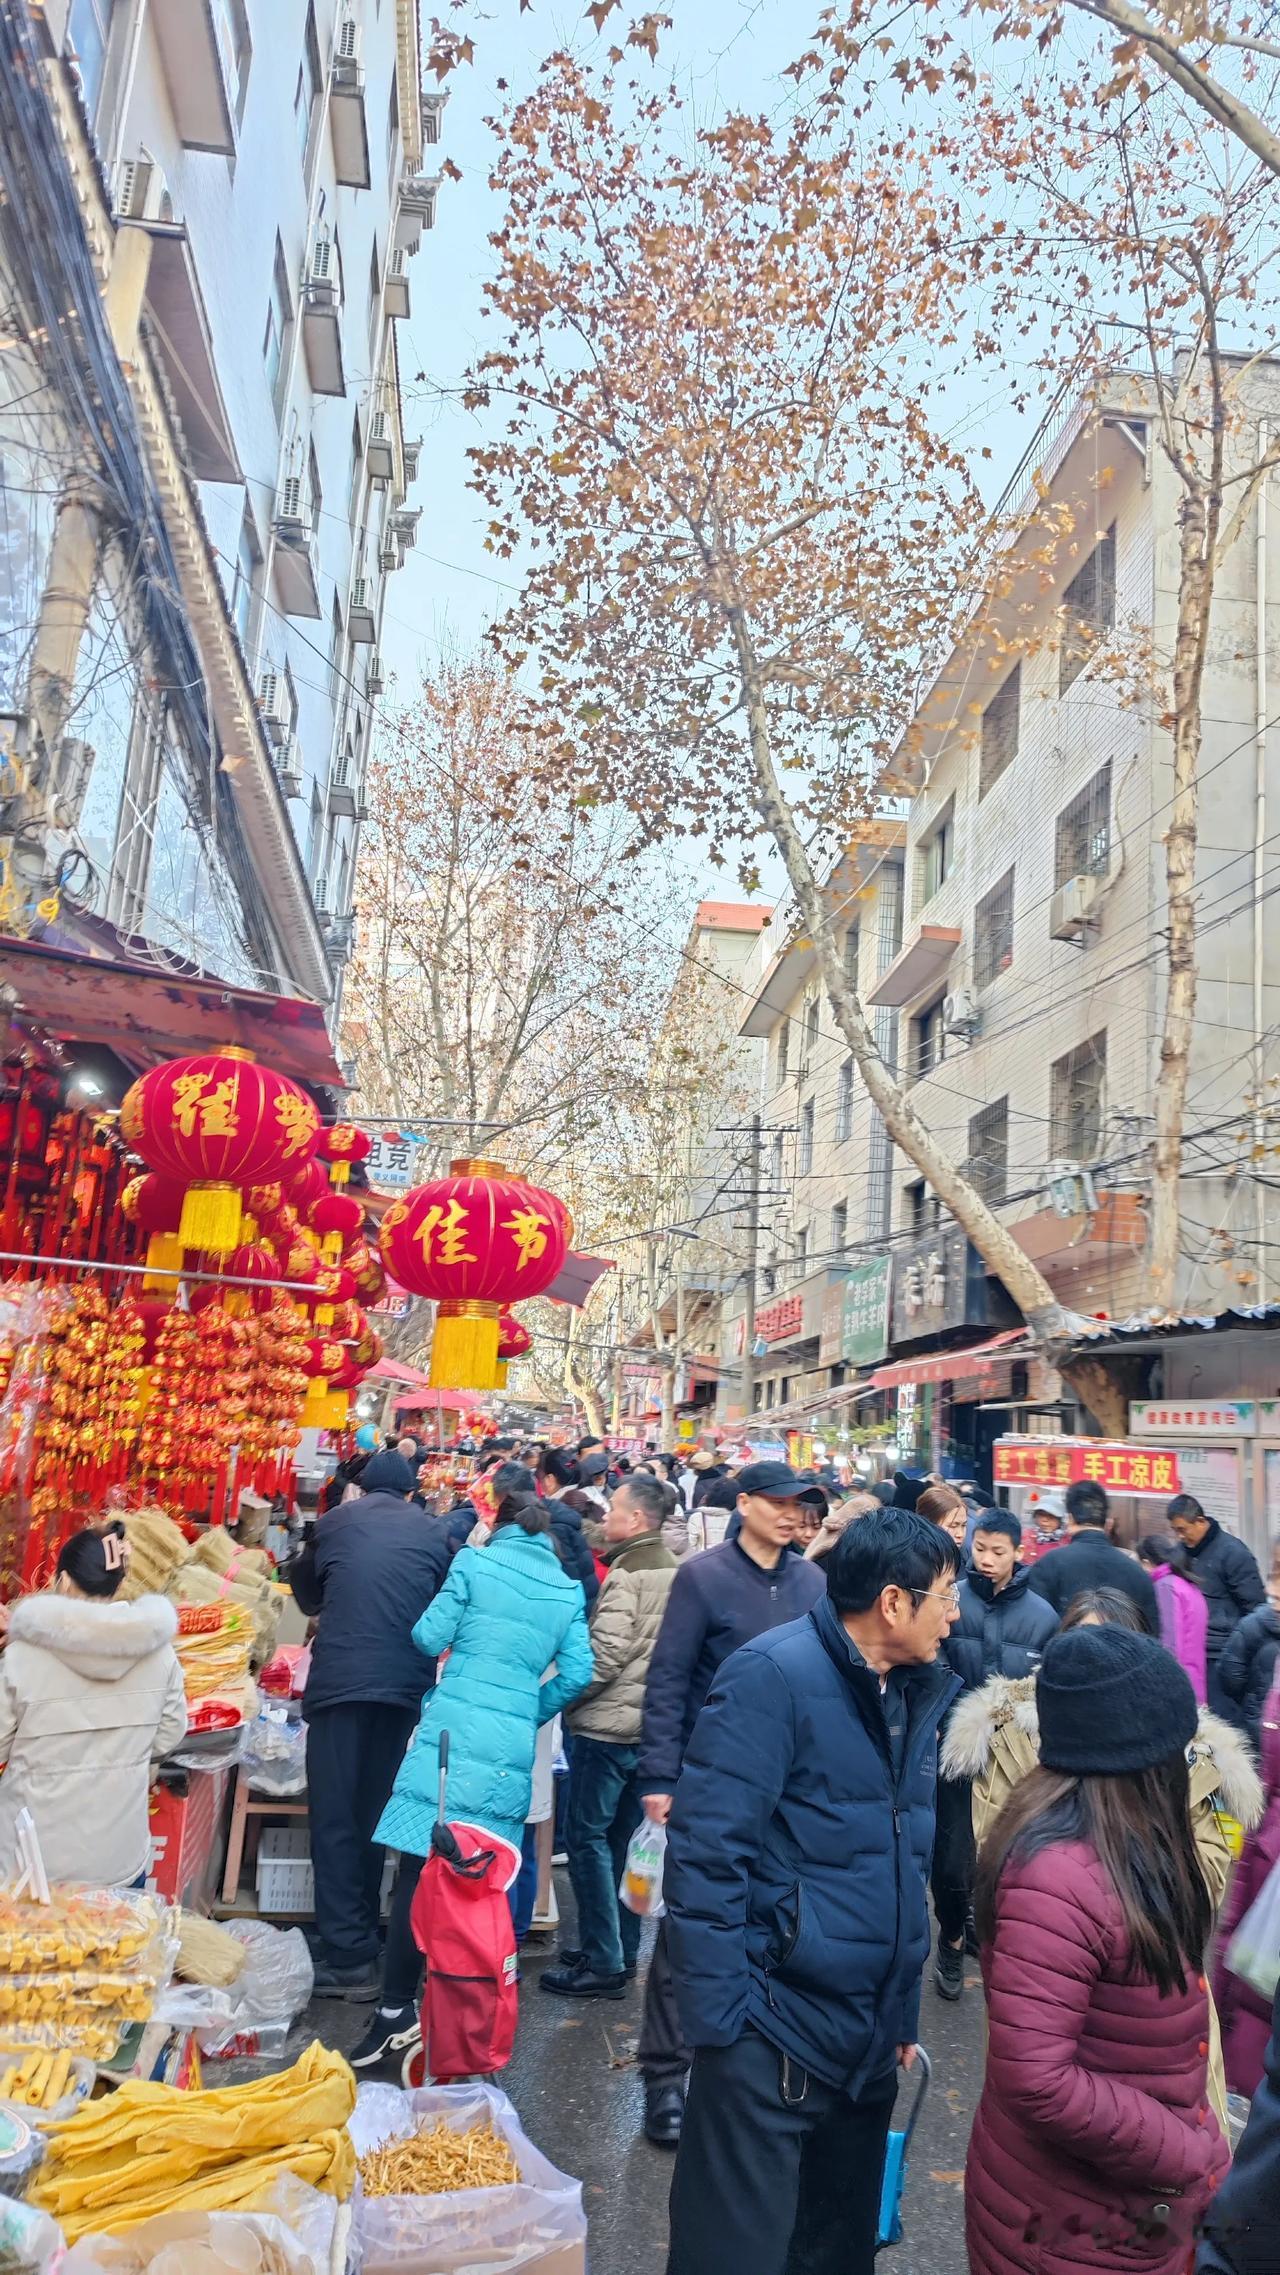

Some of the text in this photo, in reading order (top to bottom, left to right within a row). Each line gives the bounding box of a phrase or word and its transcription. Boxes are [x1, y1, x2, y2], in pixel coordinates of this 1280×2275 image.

[413, 1199, 551, 1272] 佳节
[997, 1449, 1073, 1484] 手工凉皮
[1082, 1452, 1174, 1490] 手工凉皮
